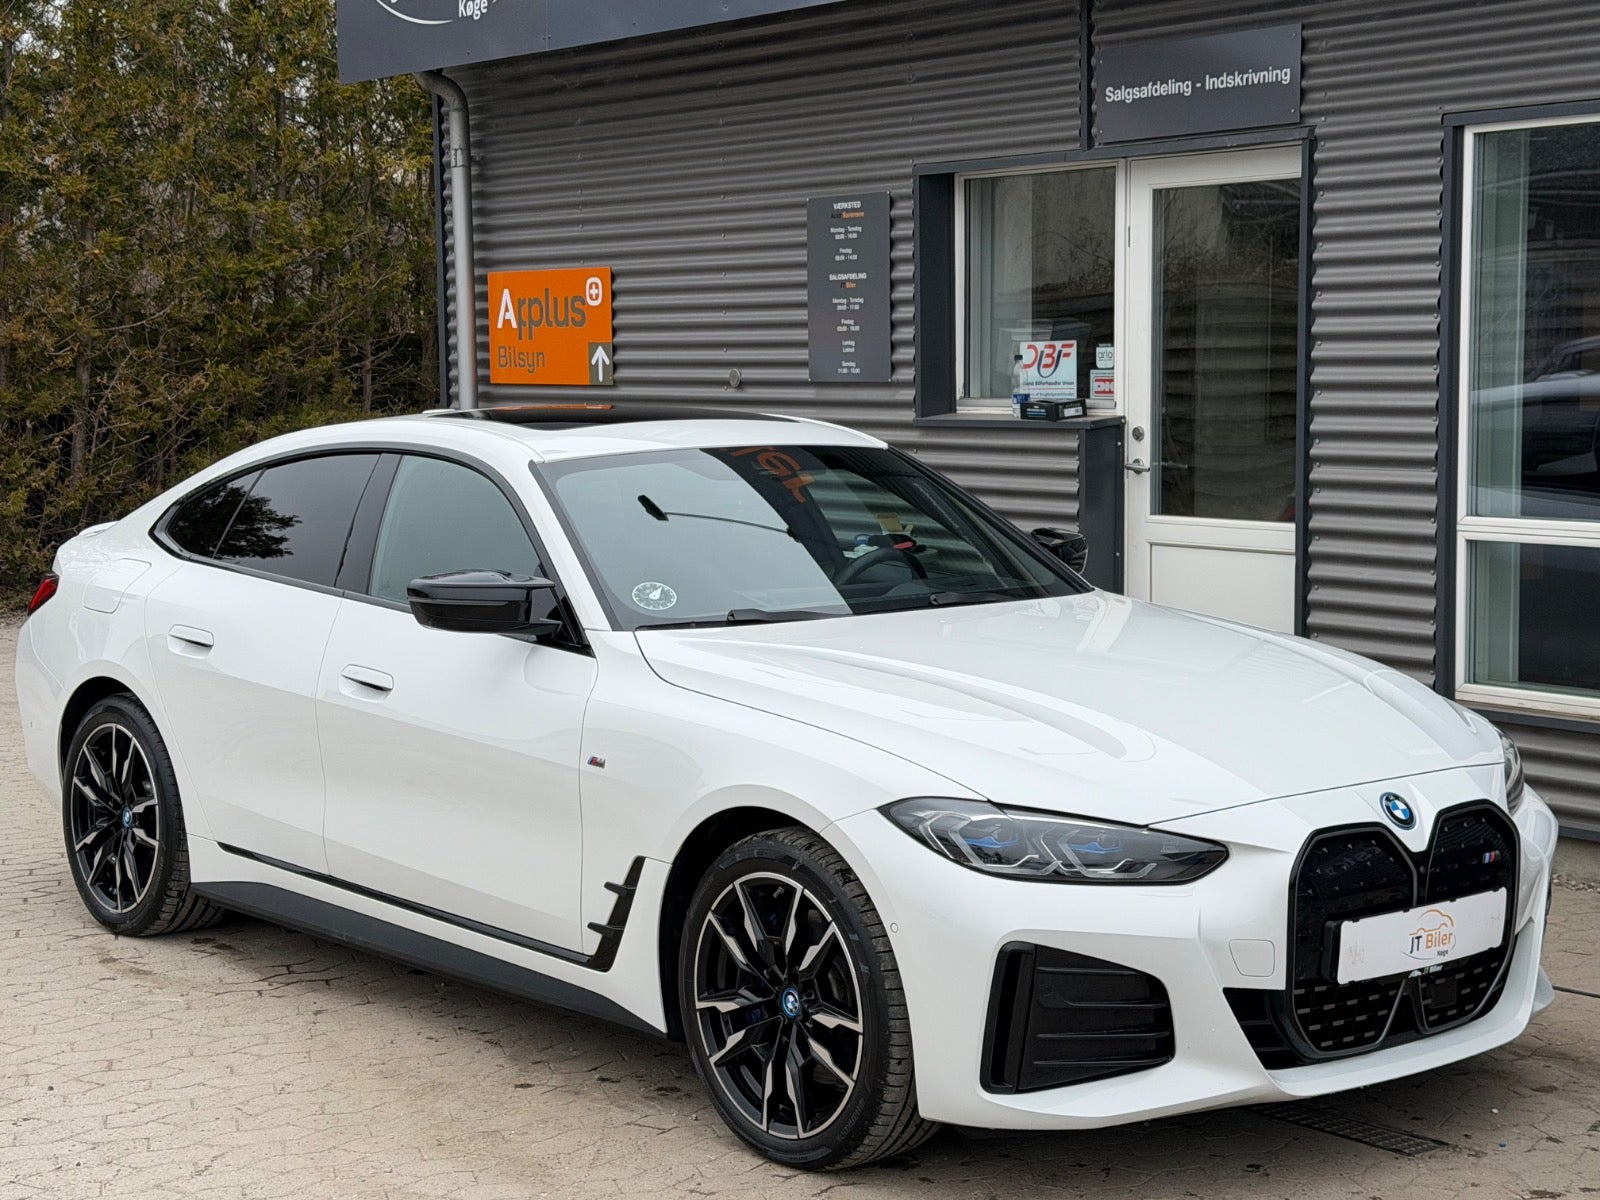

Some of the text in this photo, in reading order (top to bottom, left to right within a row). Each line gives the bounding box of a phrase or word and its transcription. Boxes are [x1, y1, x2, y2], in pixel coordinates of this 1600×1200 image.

[459, 0, 488, 20] Køge
[1105, 79, 1192, 104] Salgsafdeling
[1205, 66, 1291, 91] Indskrivning
[498, 346, 546, 374] Bilsyn
[1409, 930, 1454, 954] JT Biler
